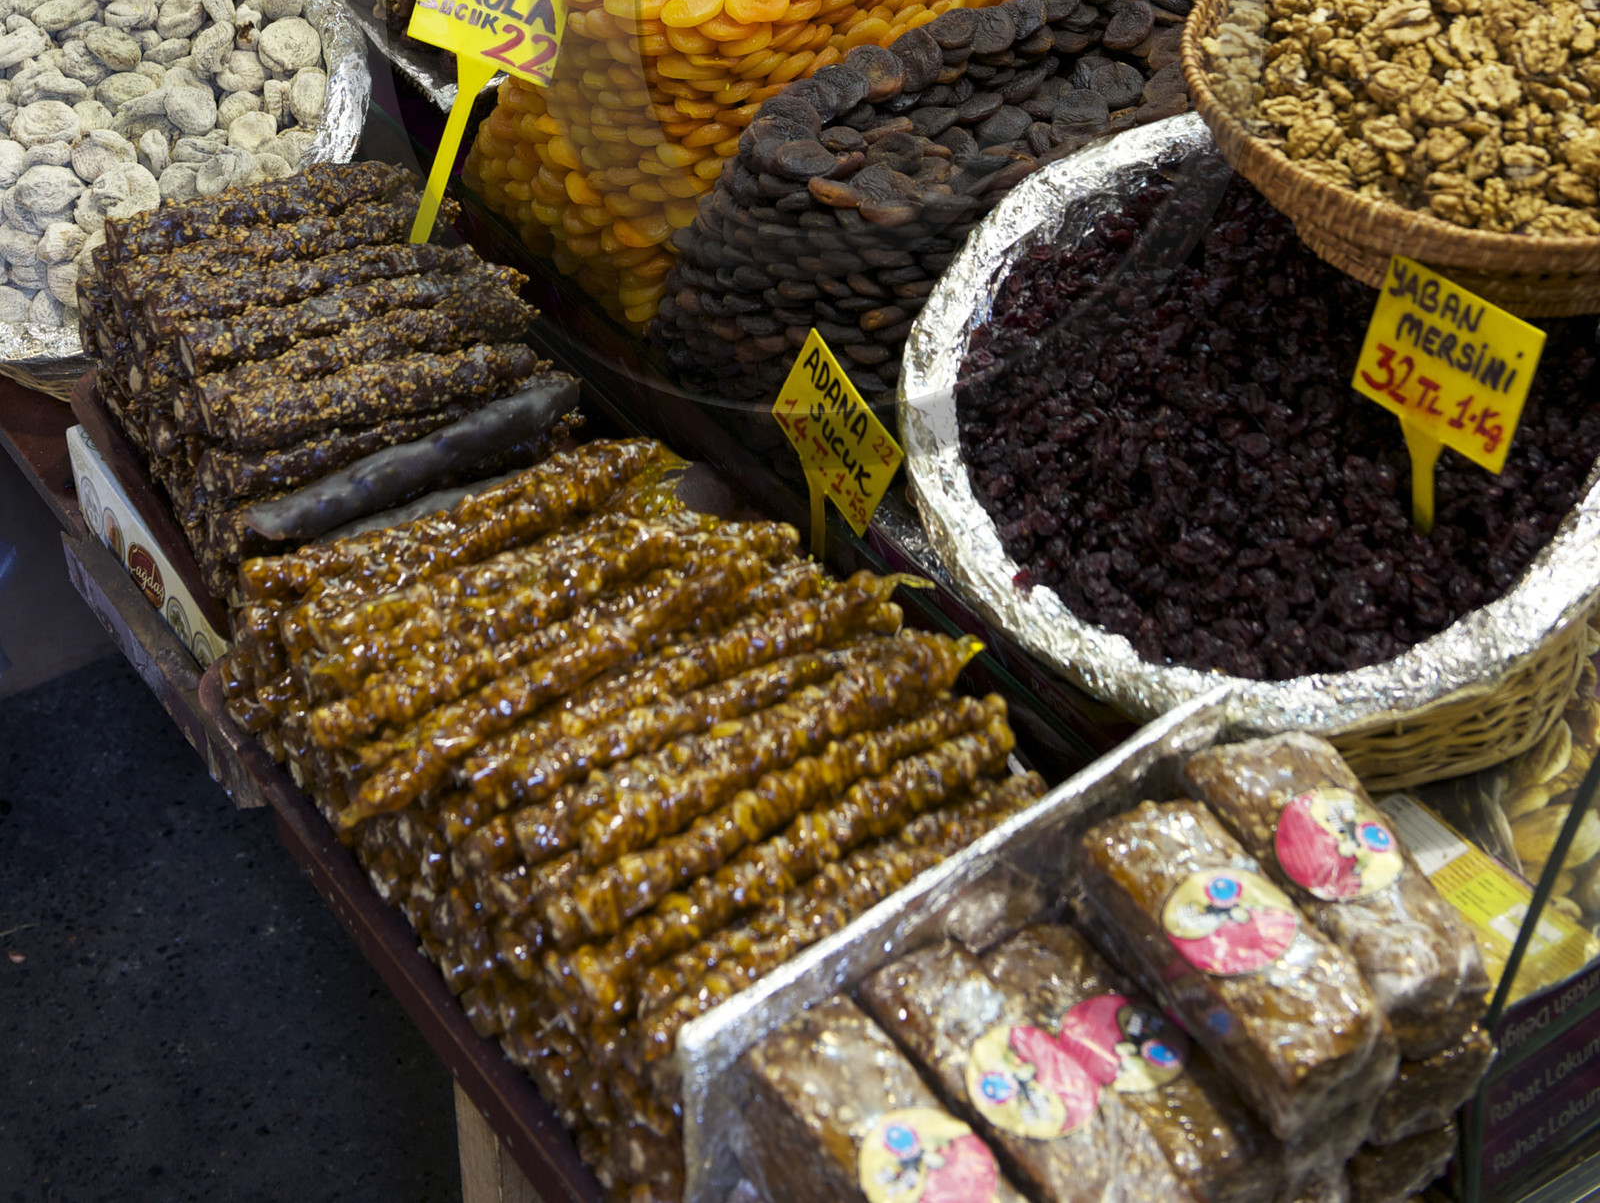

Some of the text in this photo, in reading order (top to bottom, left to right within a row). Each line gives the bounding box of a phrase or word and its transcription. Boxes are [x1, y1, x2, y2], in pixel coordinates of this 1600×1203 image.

[480, 23, 558, 84] 22
[1387, 259, 1486, 333] YABAN
[802, 346, 868, 446] ADANA
[1360, 343, 1415, 406] 32
[810, 402, 894, 498] SUCUK 22
[1490, 1077, 1541, 1127] Rahat
[1493, 1125, 1546, 1175] Rahat
